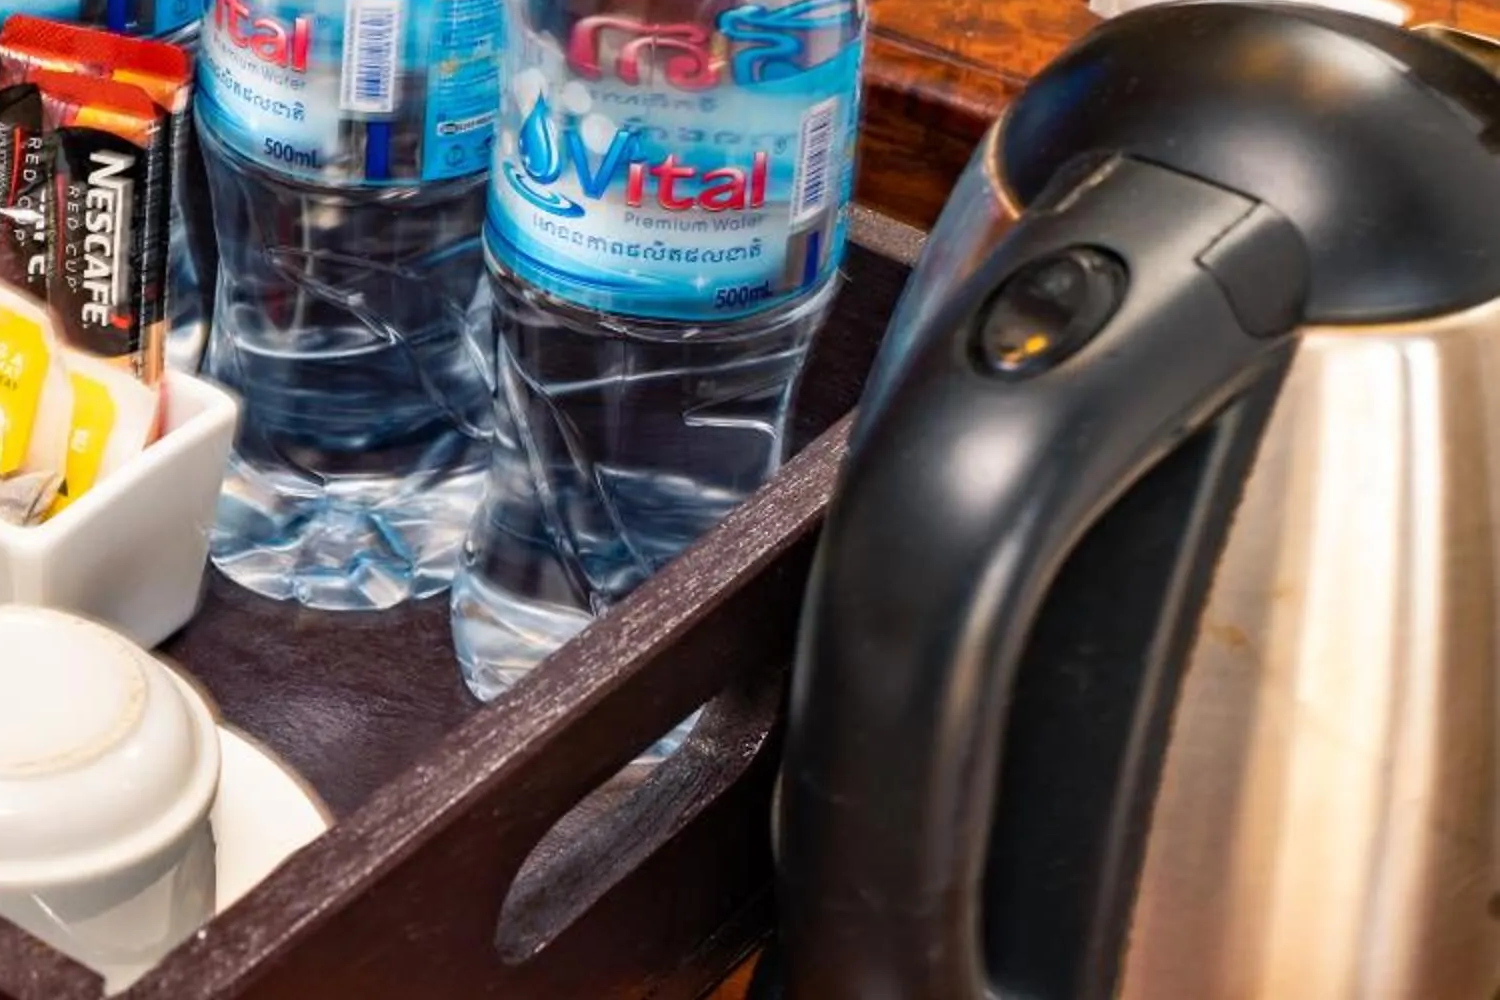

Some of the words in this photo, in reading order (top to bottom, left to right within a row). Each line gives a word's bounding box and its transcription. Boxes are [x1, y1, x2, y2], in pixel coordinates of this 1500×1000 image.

[23, 136, 42, 183] RED
[566, 128, 768, 212] Vital
[66, 185, 82, 231] RED
[624, 211, 708, 232] Premium
[713, 213, 763, 232] Water
